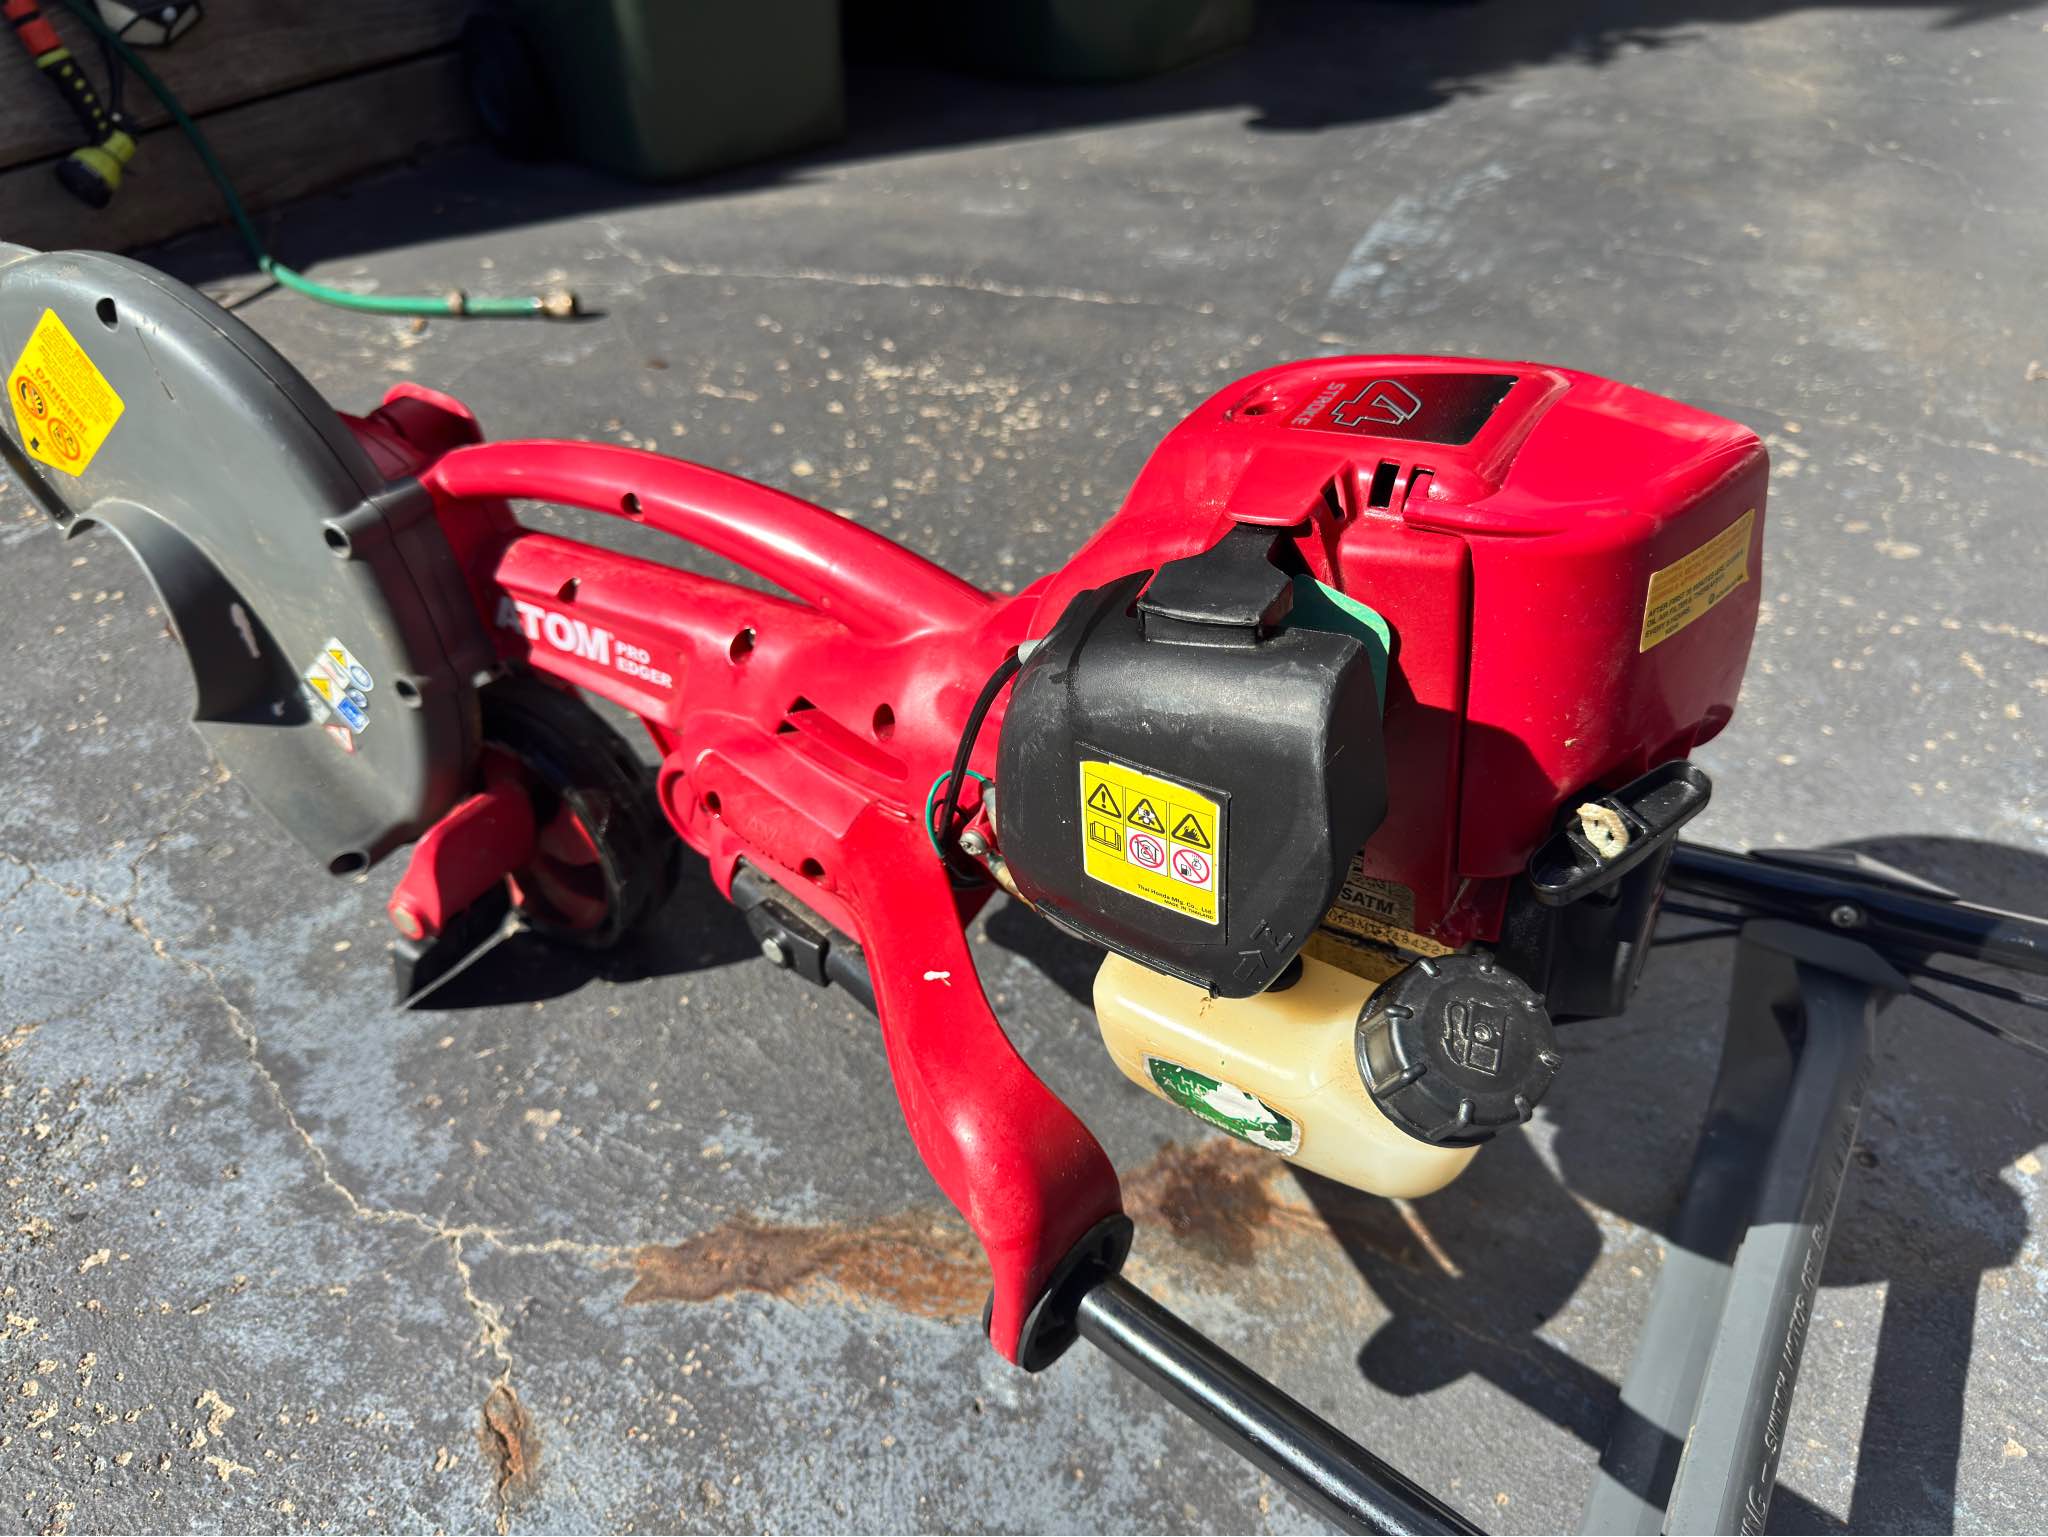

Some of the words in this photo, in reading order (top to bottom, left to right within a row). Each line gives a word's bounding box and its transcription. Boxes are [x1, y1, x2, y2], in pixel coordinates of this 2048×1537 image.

[1291, 381, 1347, 426] STROKE
[1331, 379, 1422, 427] 4
[614, 639, 650, 665] PRO
[615, 655, 673, 689] EDGER
[1151, 889, 1170, 899] Honda
[1164, 899, 1179, 908] MADE
[1188, 908, 1214, 920] THAILAND
[1340, 886, 1394, 915] SATM
[1764, 1370, 1787, 1456] SWITCH
[1783, 1293, 1805, 1370] MOTOR
